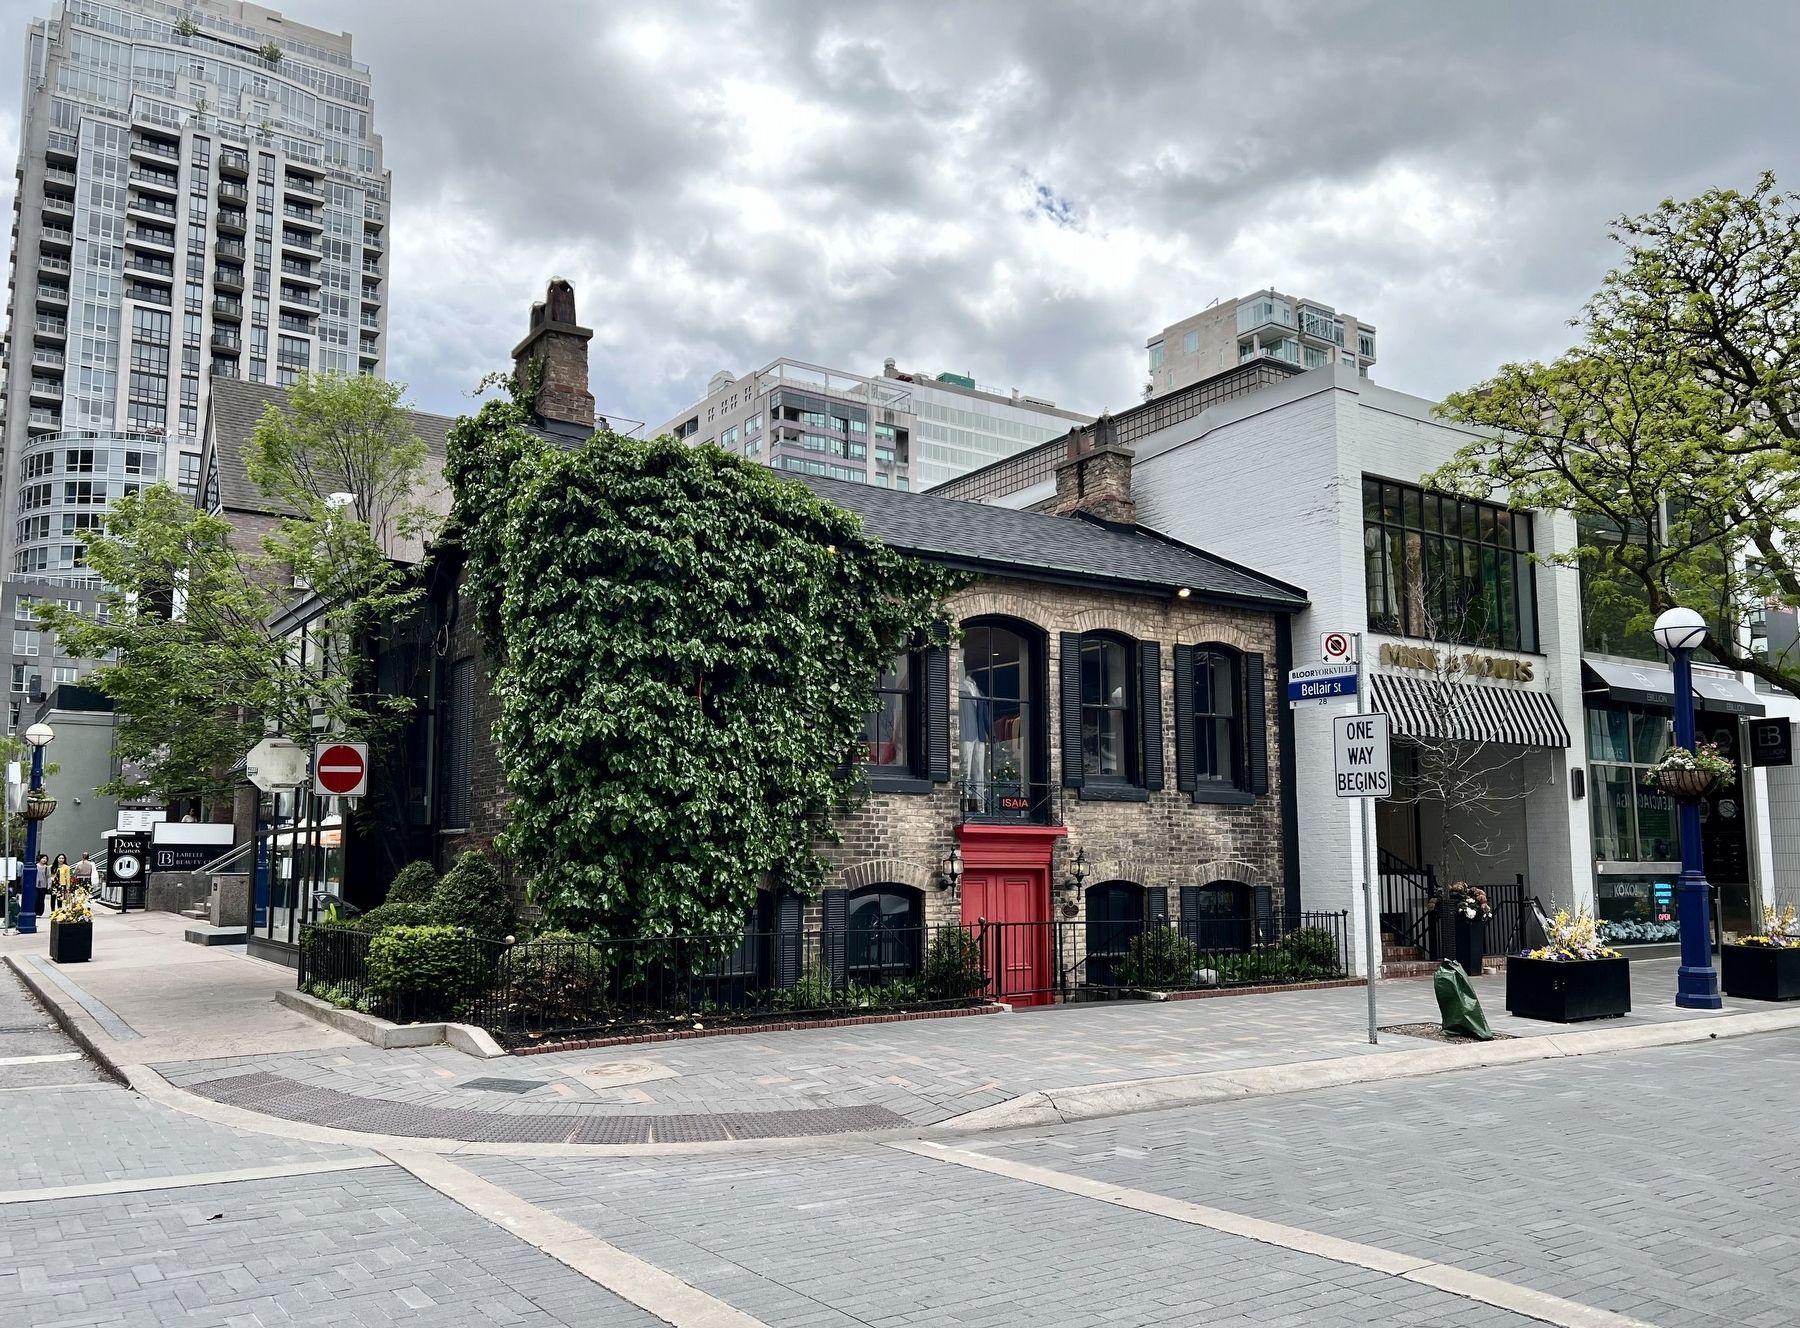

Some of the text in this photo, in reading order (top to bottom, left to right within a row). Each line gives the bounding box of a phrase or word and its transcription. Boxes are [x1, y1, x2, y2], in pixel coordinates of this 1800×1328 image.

[1301, 681, 1341, 696] Bellair St
[1347, 721, 1374, 740] ONE
[1347, 746, 1374, 765] WAY
[1338, 771, 1387, 791] BEGINS
[1002, 799, 1029, 808] ISAIA
[114, 838, 142, 849] Dove
[1658, 913, 1671, 921] OPEN
